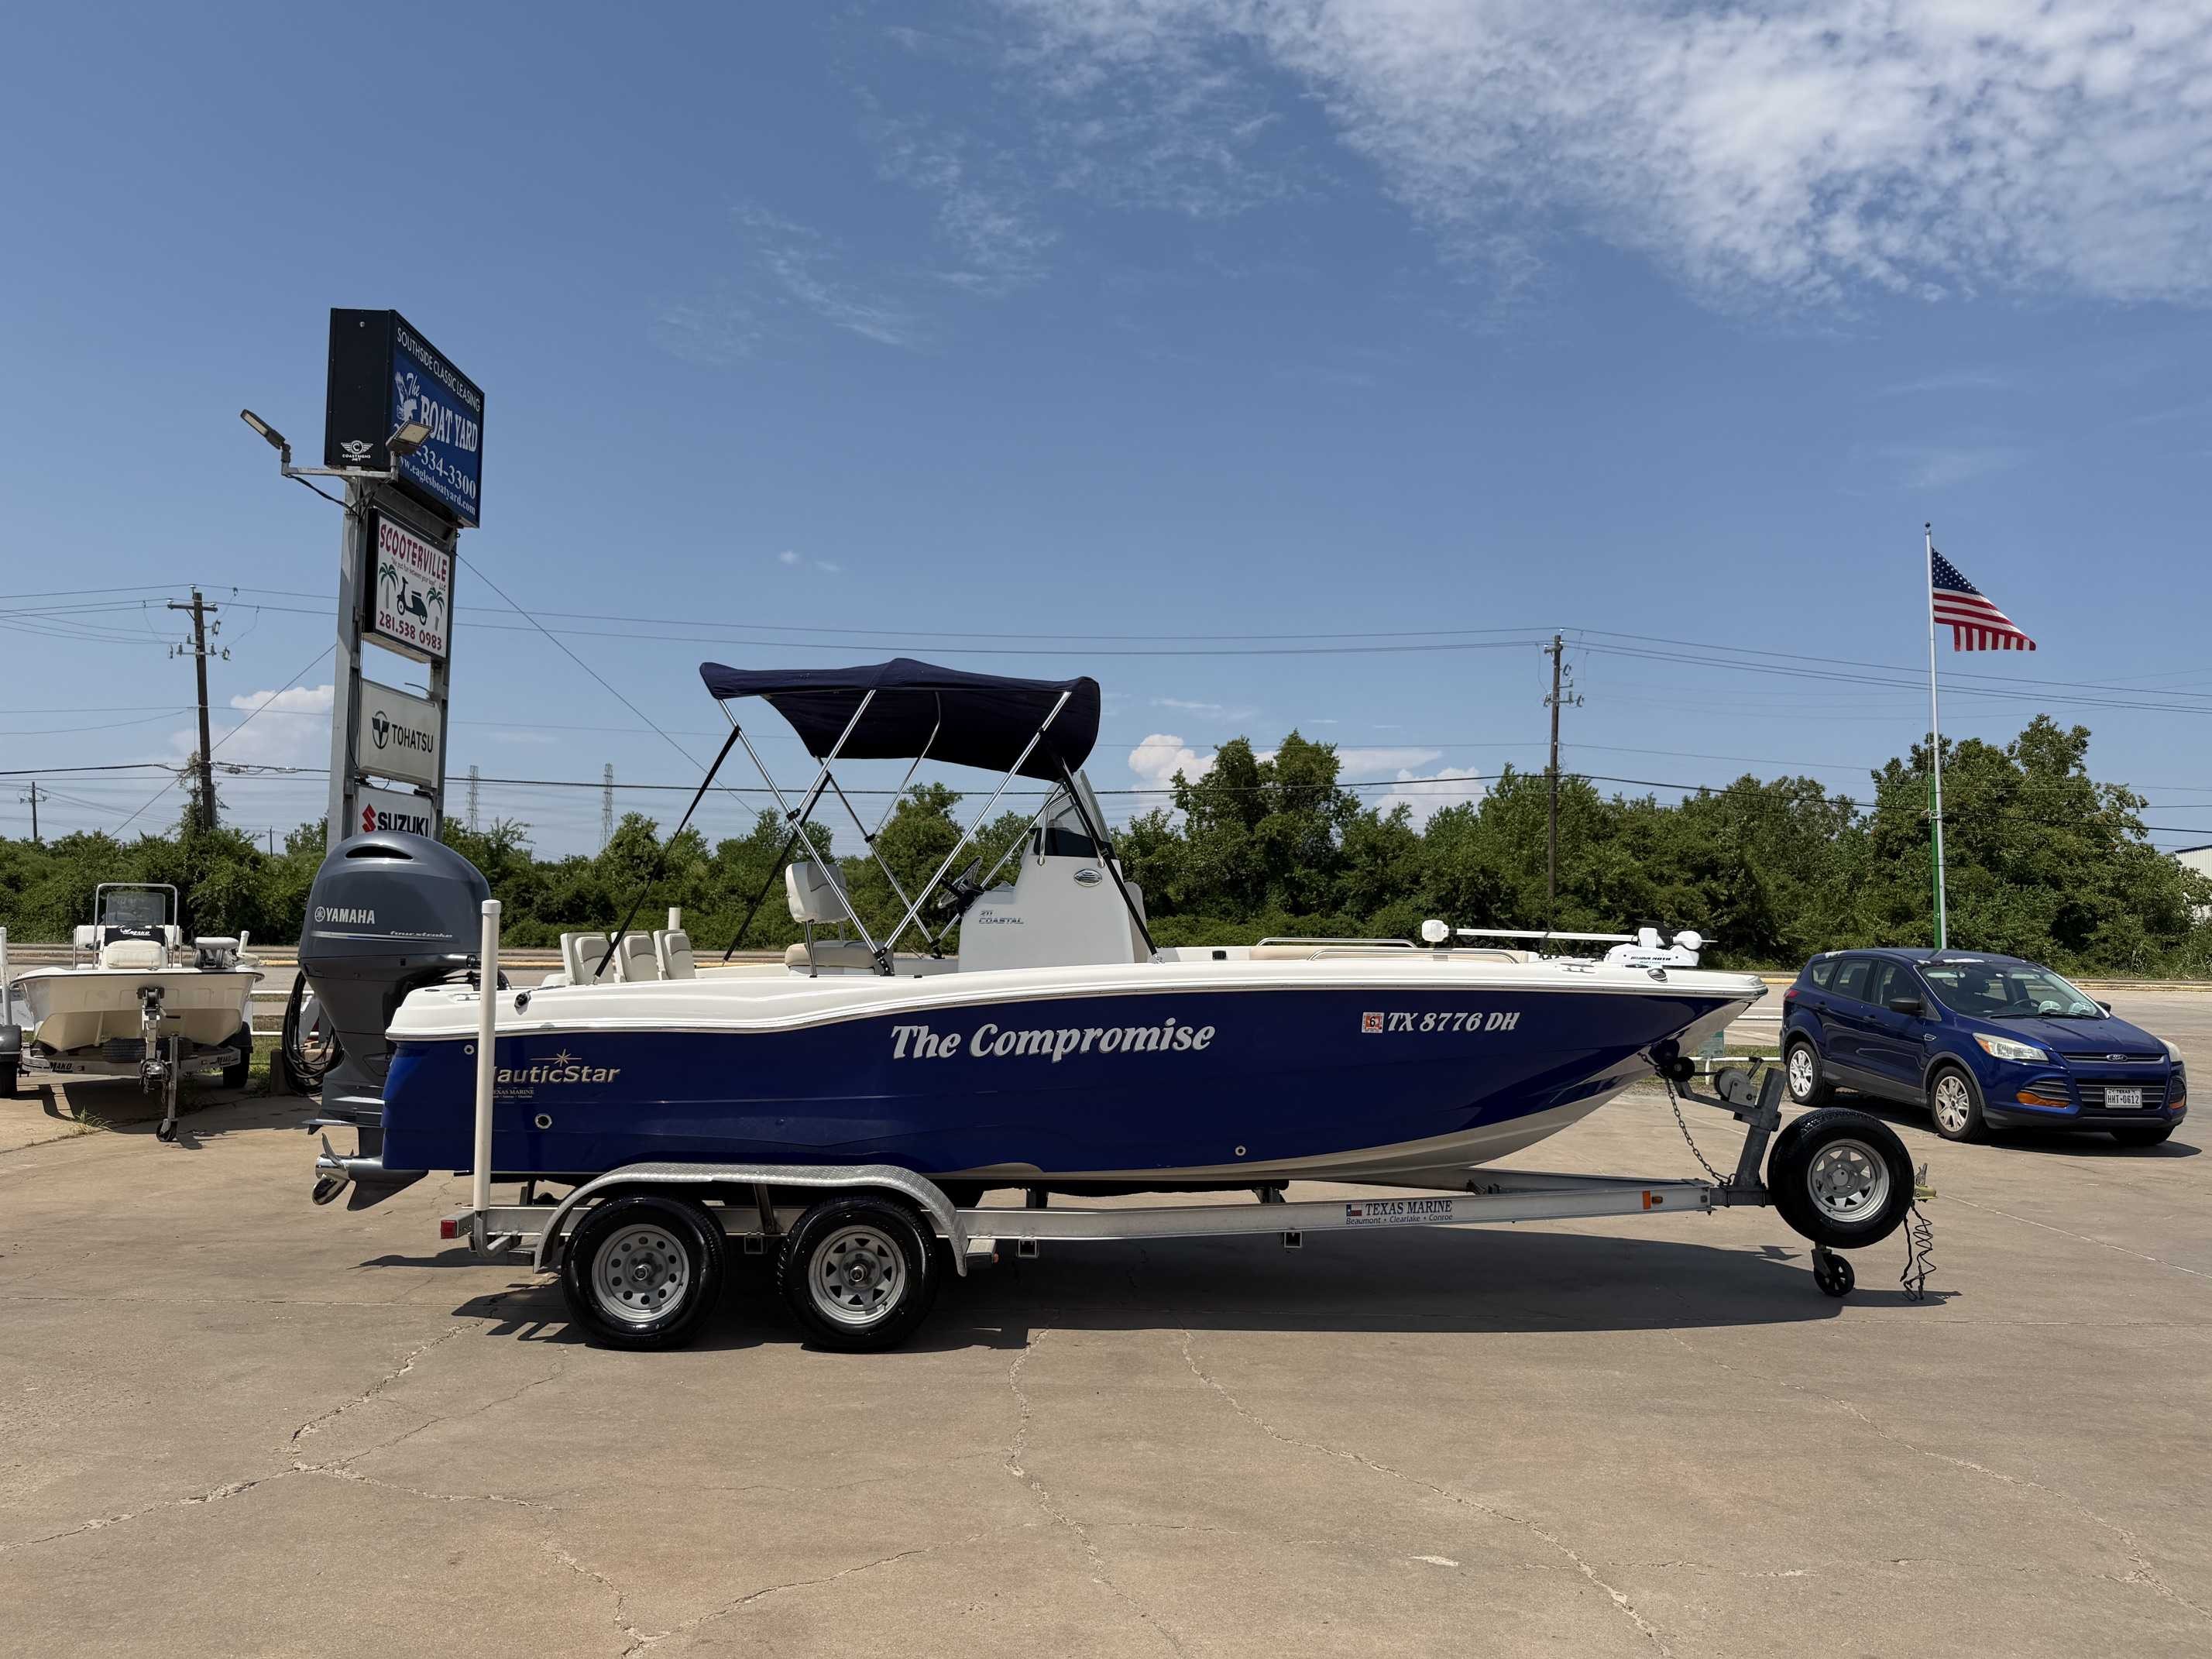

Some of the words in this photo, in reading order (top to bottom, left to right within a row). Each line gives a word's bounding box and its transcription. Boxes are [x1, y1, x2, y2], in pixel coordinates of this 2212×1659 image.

[397, 327, 433, 370] SOUTHSIDE
[434, 360, 456, 392] CLASSIC
[456, 381, 480, 412] LEASING
[407, 373, 420, 397] The
[421, 394, 452, 444] BOAT
[455, 413, 478, 452] YARD
[380, 524, 448, 582] SCOOTERVILLE
[380, 610, 416, 640] 281.538
[419, 630, 441, 651] 0983
[392, 724, 434, 753] TOHATSU
[377, 812, 429, 836] SUZUKI
[326, 907, 376, 925] YAMAHA
[1369, 1015, 1376, 1028] 6
[1387, 1012, 1419, 1032] TX
[1419, 1012, 1483, 1032] 8776
[1484, 1012, 1521, 1032] DH
[891, 1024, 961, 1060] The
[969, 1017, 1216, 1064] Compromise
[493, 1065, 620, 1084] auticStar
[1346, 1217, 1381, 1225] Beaumont
[1389, 1215, 1420, 1224] Clearlake
[1428, 1213, 1453, 1221] Conroe
[1365, 1201, 1404, 1216] TEXAS
[1407, 1200, 1452, 1214] MARINE
